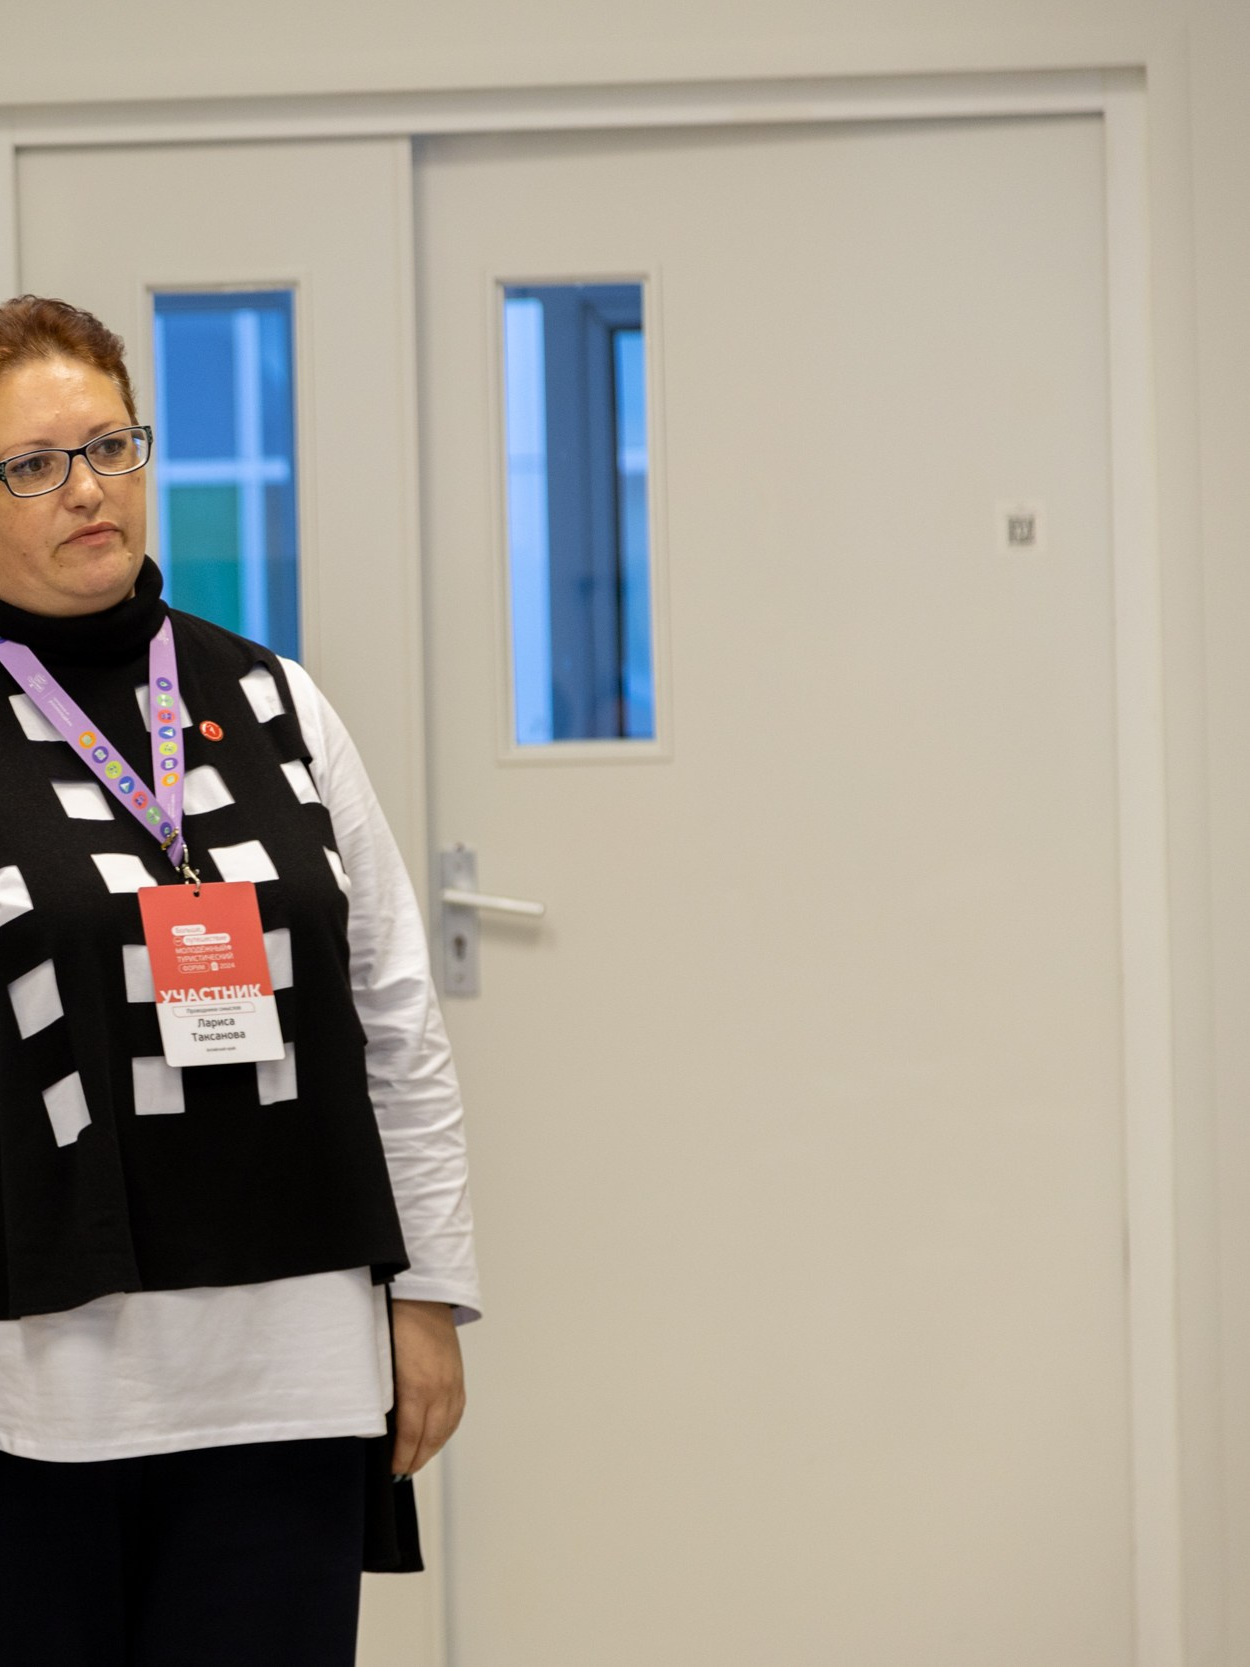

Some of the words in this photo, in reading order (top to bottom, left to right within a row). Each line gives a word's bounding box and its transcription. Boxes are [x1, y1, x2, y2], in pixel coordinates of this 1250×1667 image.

[160, 984, 262, 1004] УЧАСТНИК
[197, 1017, 236, 1029] Лариса
[191, 1030, 246, 1043] Таксанова
